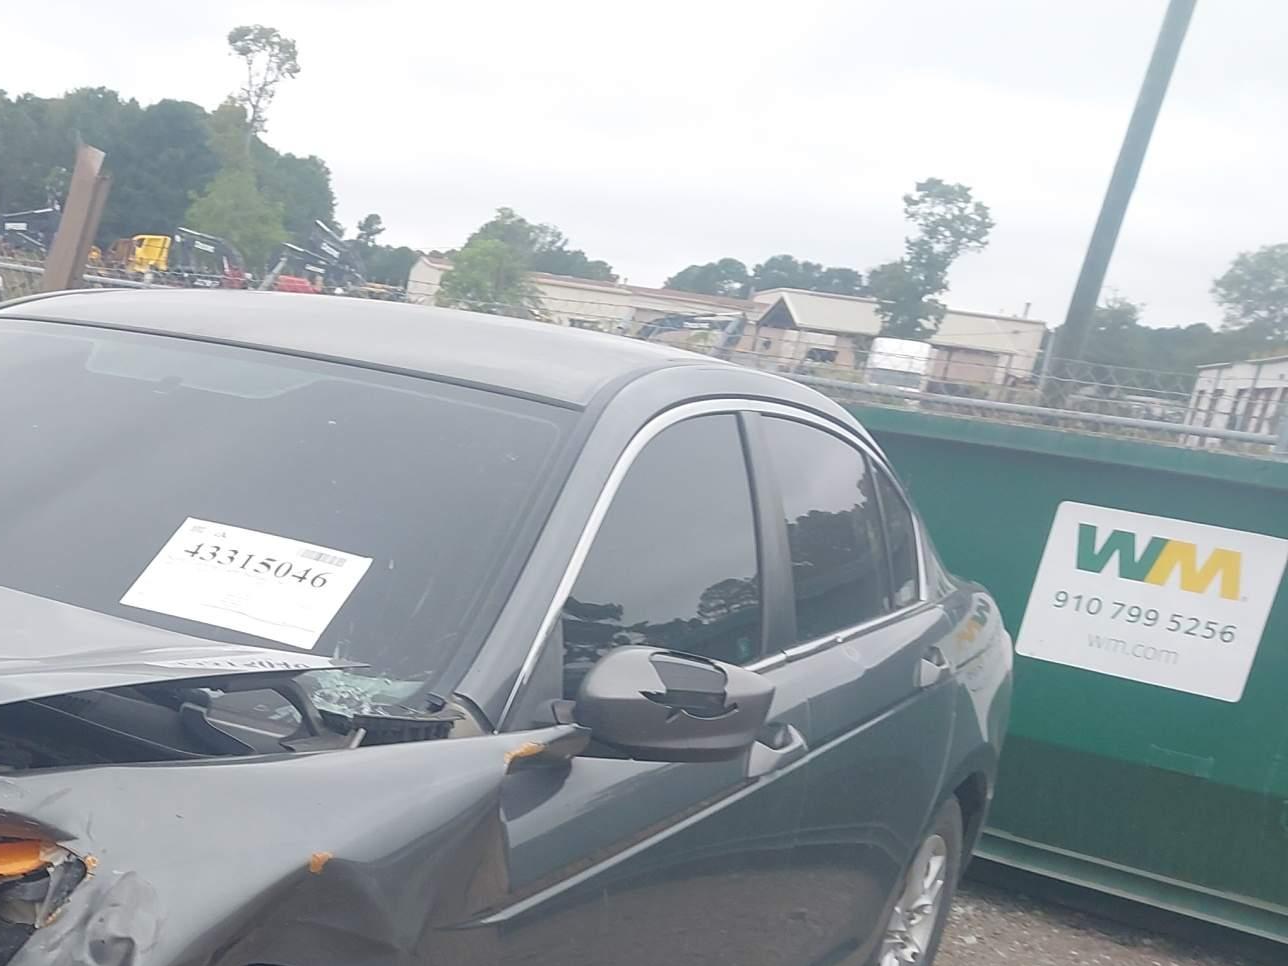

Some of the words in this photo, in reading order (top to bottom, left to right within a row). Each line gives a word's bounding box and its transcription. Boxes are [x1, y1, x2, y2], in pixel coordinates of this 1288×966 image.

[184, 543, 333, 588] 43315046
[1076, 523, 1242, 601] WM
[1052, 590, 1102, 615] 910
[1111, 602, 1159, 627] 799
[1166, 614, 1237, 643] 5256
[1087, 635, 1179, 664] wm.com
